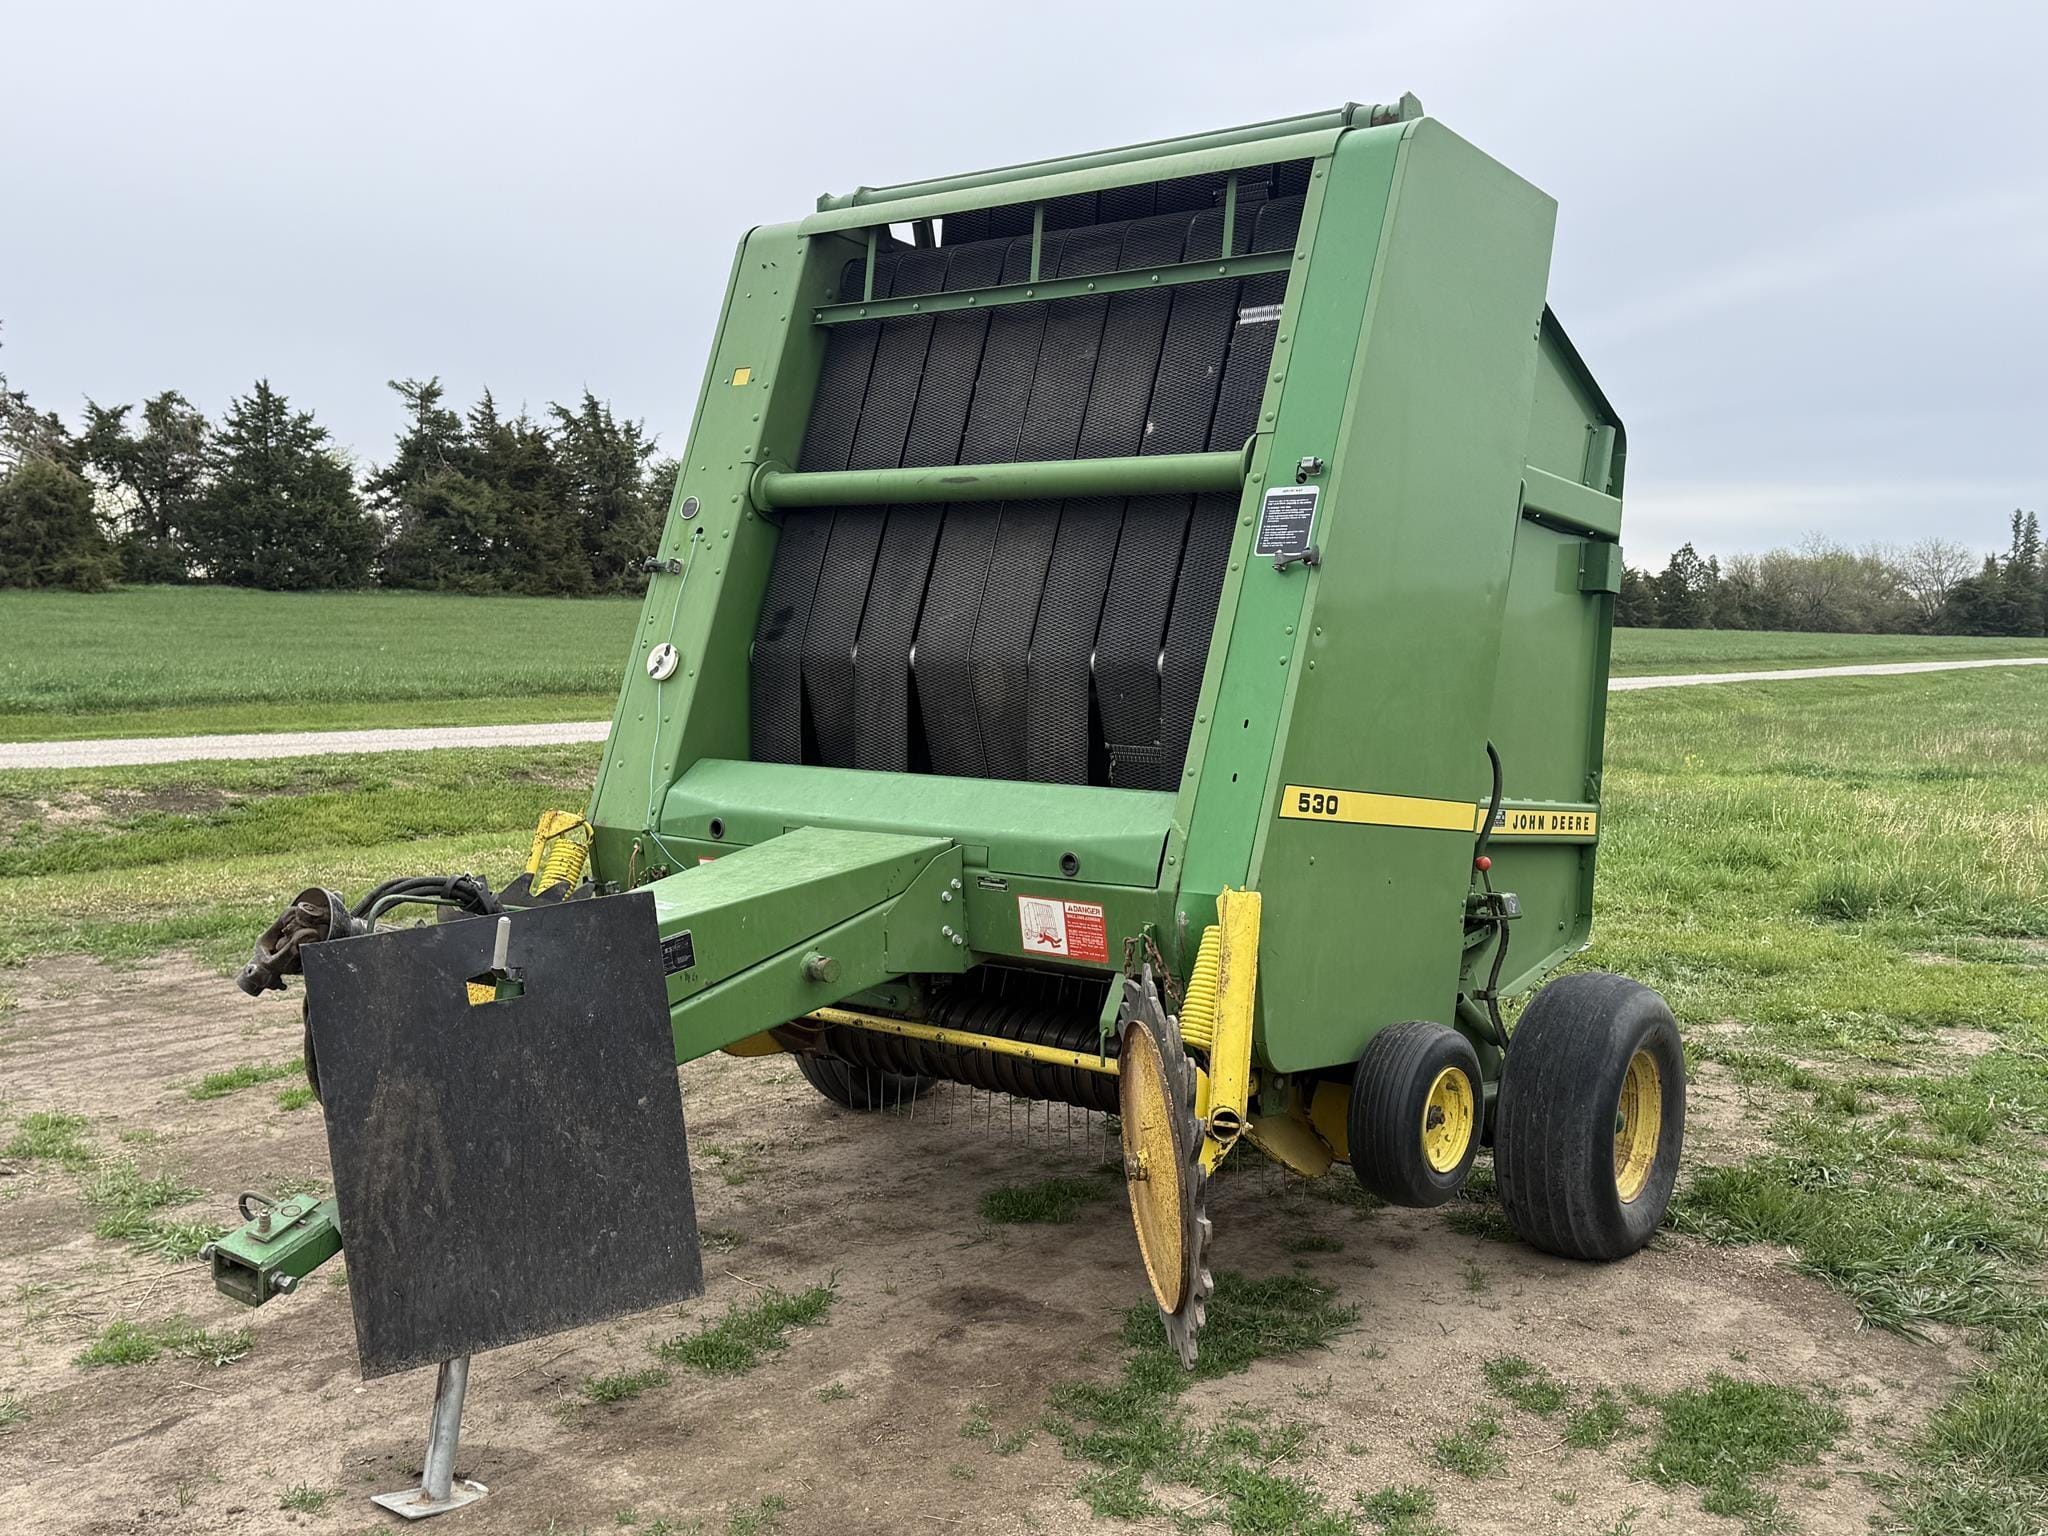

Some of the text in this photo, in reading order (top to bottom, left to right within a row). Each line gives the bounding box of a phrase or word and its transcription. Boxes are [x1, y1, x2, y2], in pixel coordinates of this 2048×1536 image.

[1298, 792, 1338, 815] 530
[1513, 815, 1545, 830] JOHN
[1552, 816, 1590, 831] DEERE
[1074, 906, 1101, 915] DANGER
